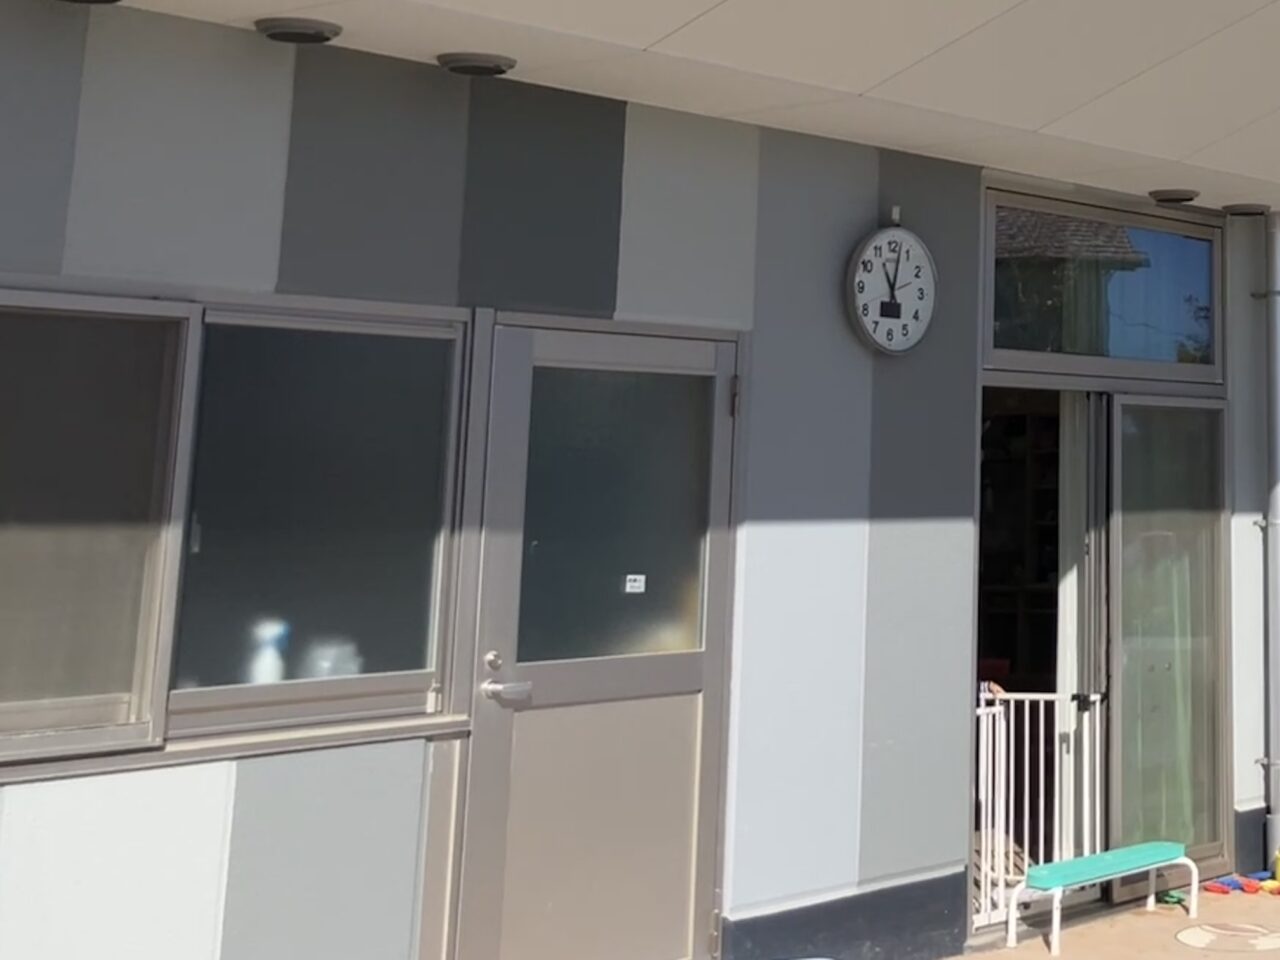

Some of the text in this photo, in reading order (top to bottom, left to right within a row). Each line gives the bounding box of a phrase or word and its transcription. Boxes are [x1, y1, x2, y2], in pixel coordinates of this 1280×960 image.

[873, 245, 882, 258] 11
[887, 240, 898, 254] 12
[905, 249, 910, 262] 1
[861, 259, 873, 273] 10
[914, 265, 921, 278] 2
[857, 280, 865, 294] 9
[917, 287, 925, 301] 3
[862, 303, 869, 317] 8
[913, 309, 920, 322] 4
[872, 321, 879, 334] 7
[902, 324, 909, 337] 5
[886, 328, 893, 341] 6
